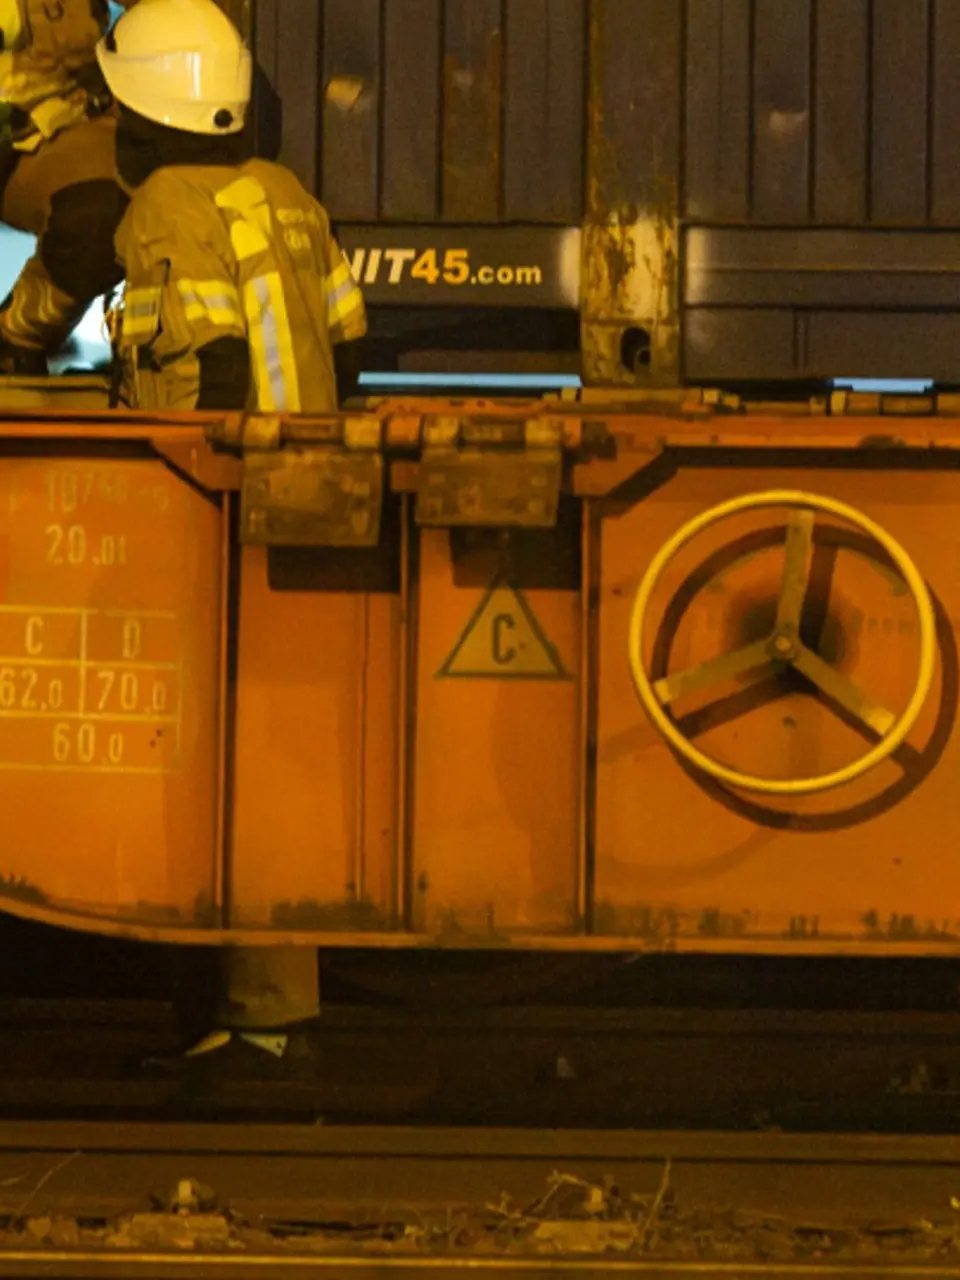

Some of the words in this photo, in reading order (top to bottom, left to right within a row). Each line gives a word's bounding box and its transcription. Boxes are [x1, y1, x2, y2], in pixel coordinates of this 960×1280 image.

[25, 616, 45, 656] C
[121, 619, 142, 659] D
[492, 613, 516, 665] C
